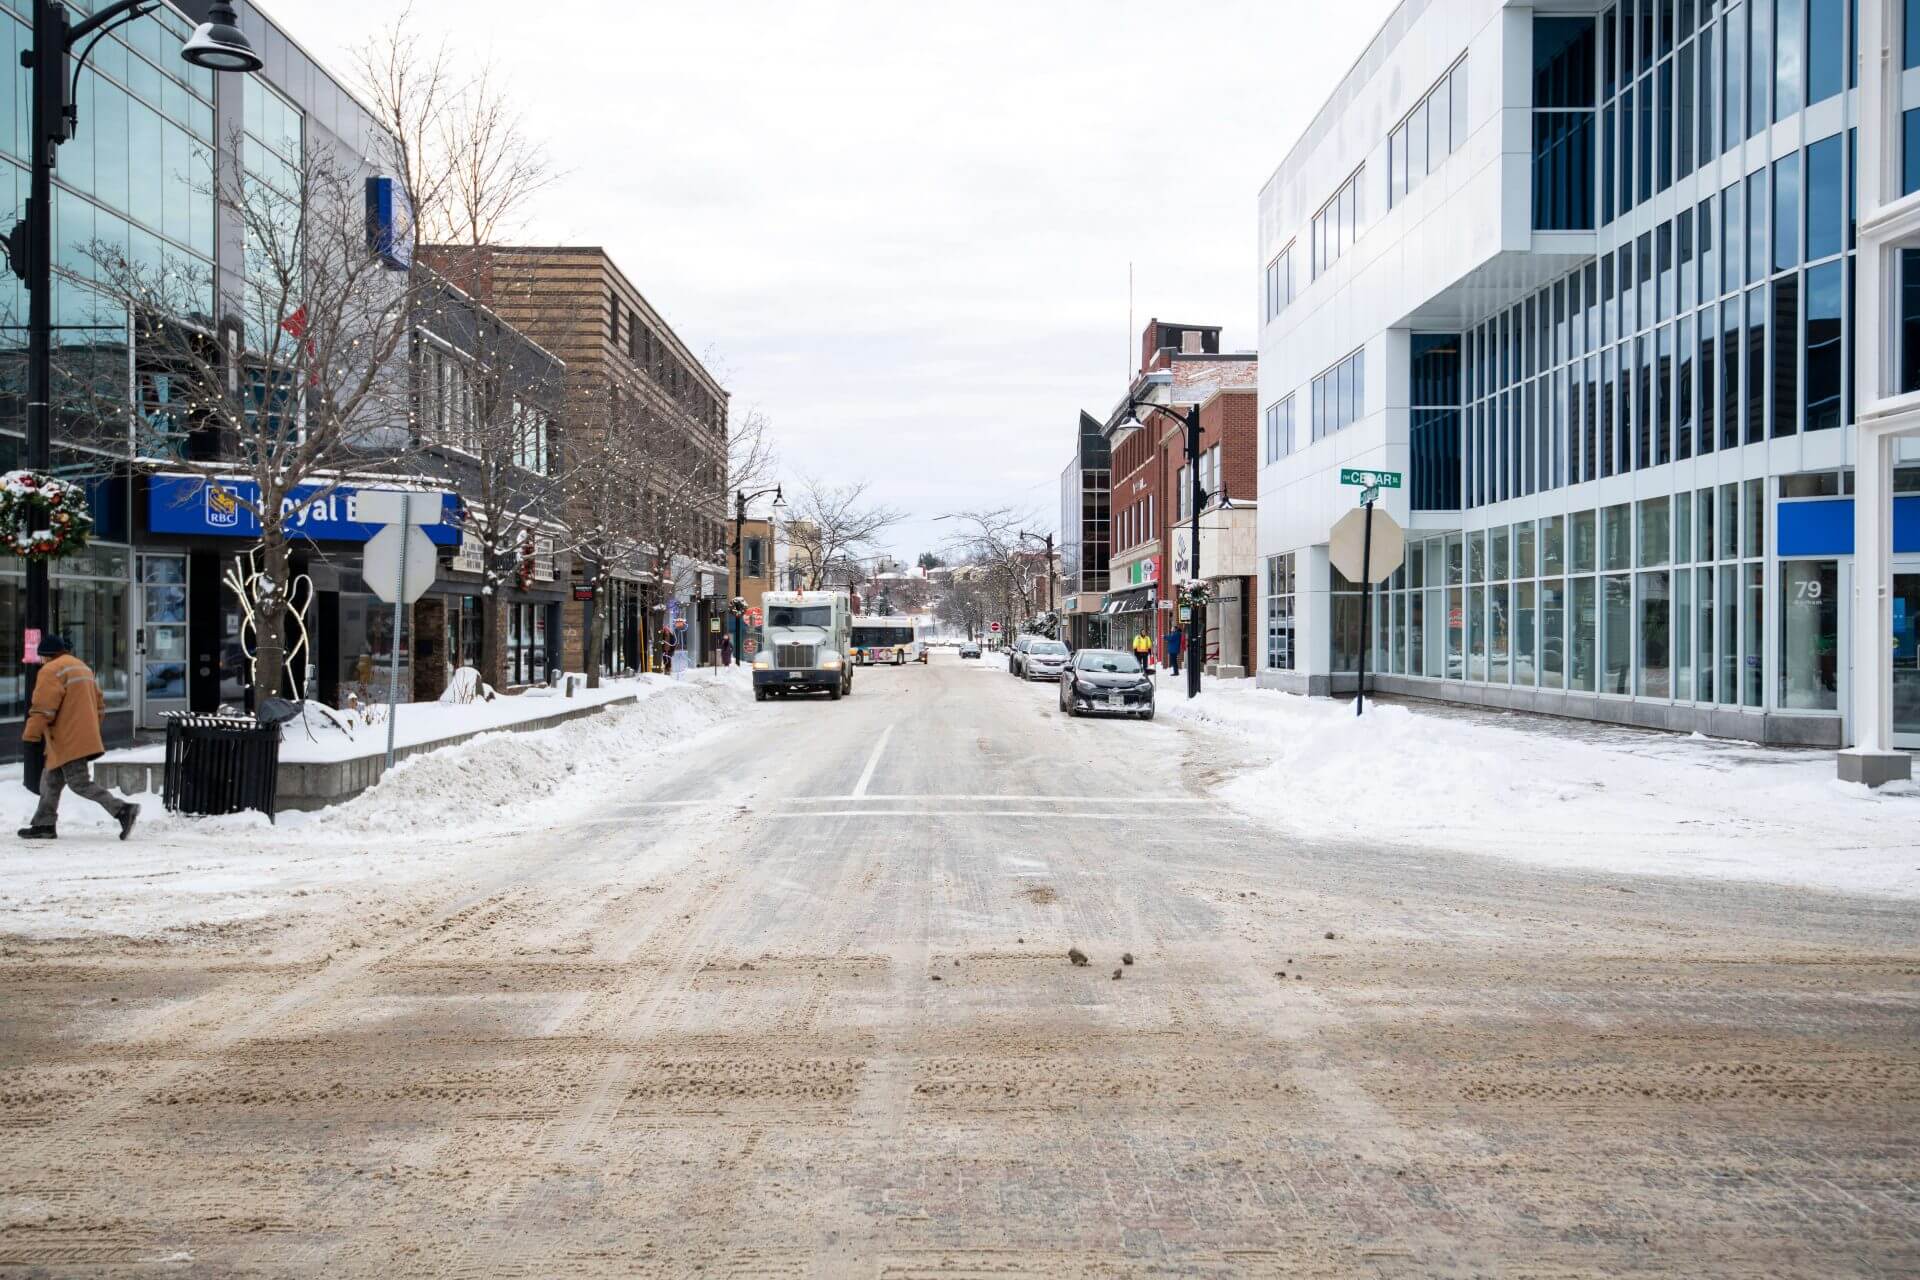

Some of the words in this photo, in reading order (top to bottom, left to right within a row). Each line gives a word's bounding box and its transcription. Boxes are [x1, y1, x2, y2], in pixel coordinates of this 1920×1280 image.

[256, 493, 338, 526] oyal
[211, 513, 234, 524] RBC
[1794, 581, 1822, 598] 79
